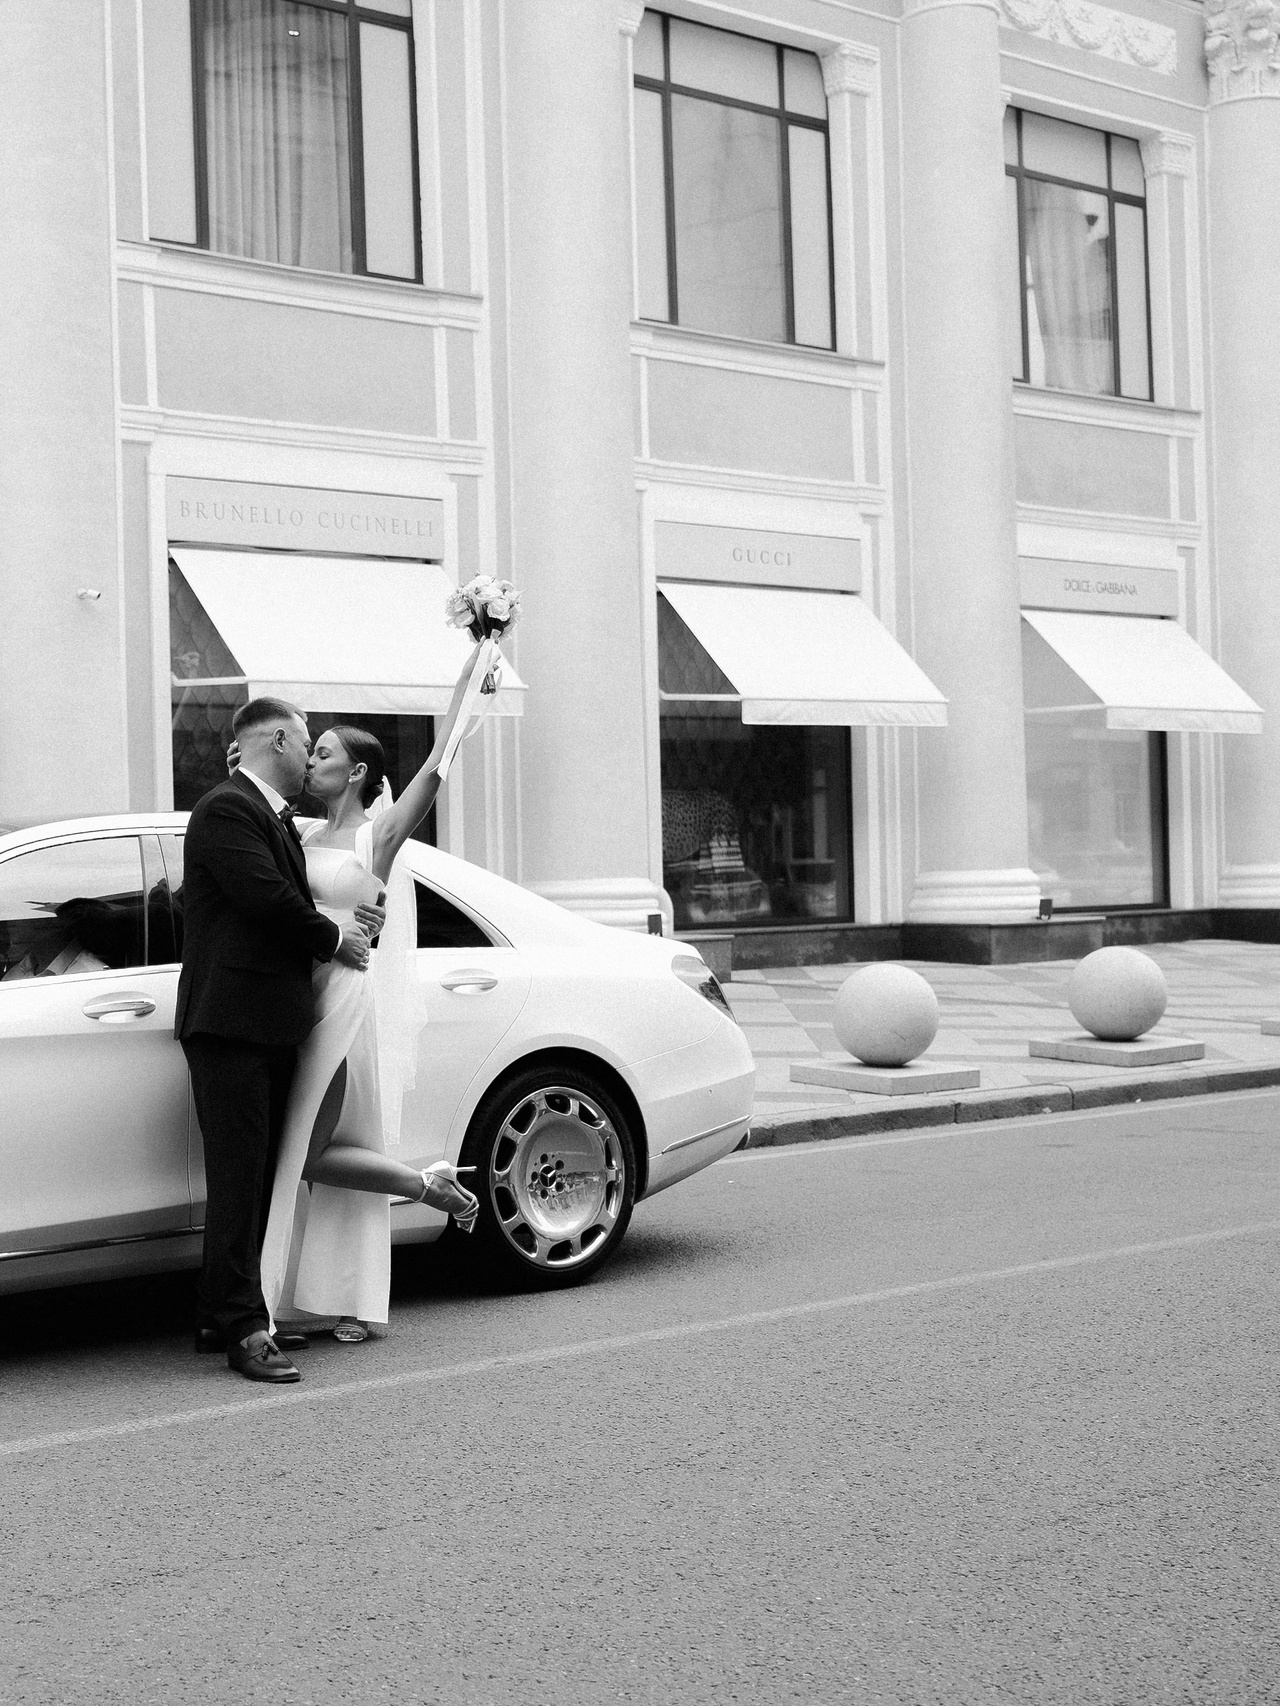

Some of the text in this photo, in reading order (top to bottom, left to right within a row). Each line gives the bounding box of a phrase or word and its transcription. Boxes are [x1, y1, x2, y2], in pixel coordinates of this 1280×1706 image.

[179, 500, 433, 538] BRUNELLO CUCINELLI
[732, 547, 791, 567] GUCCI
